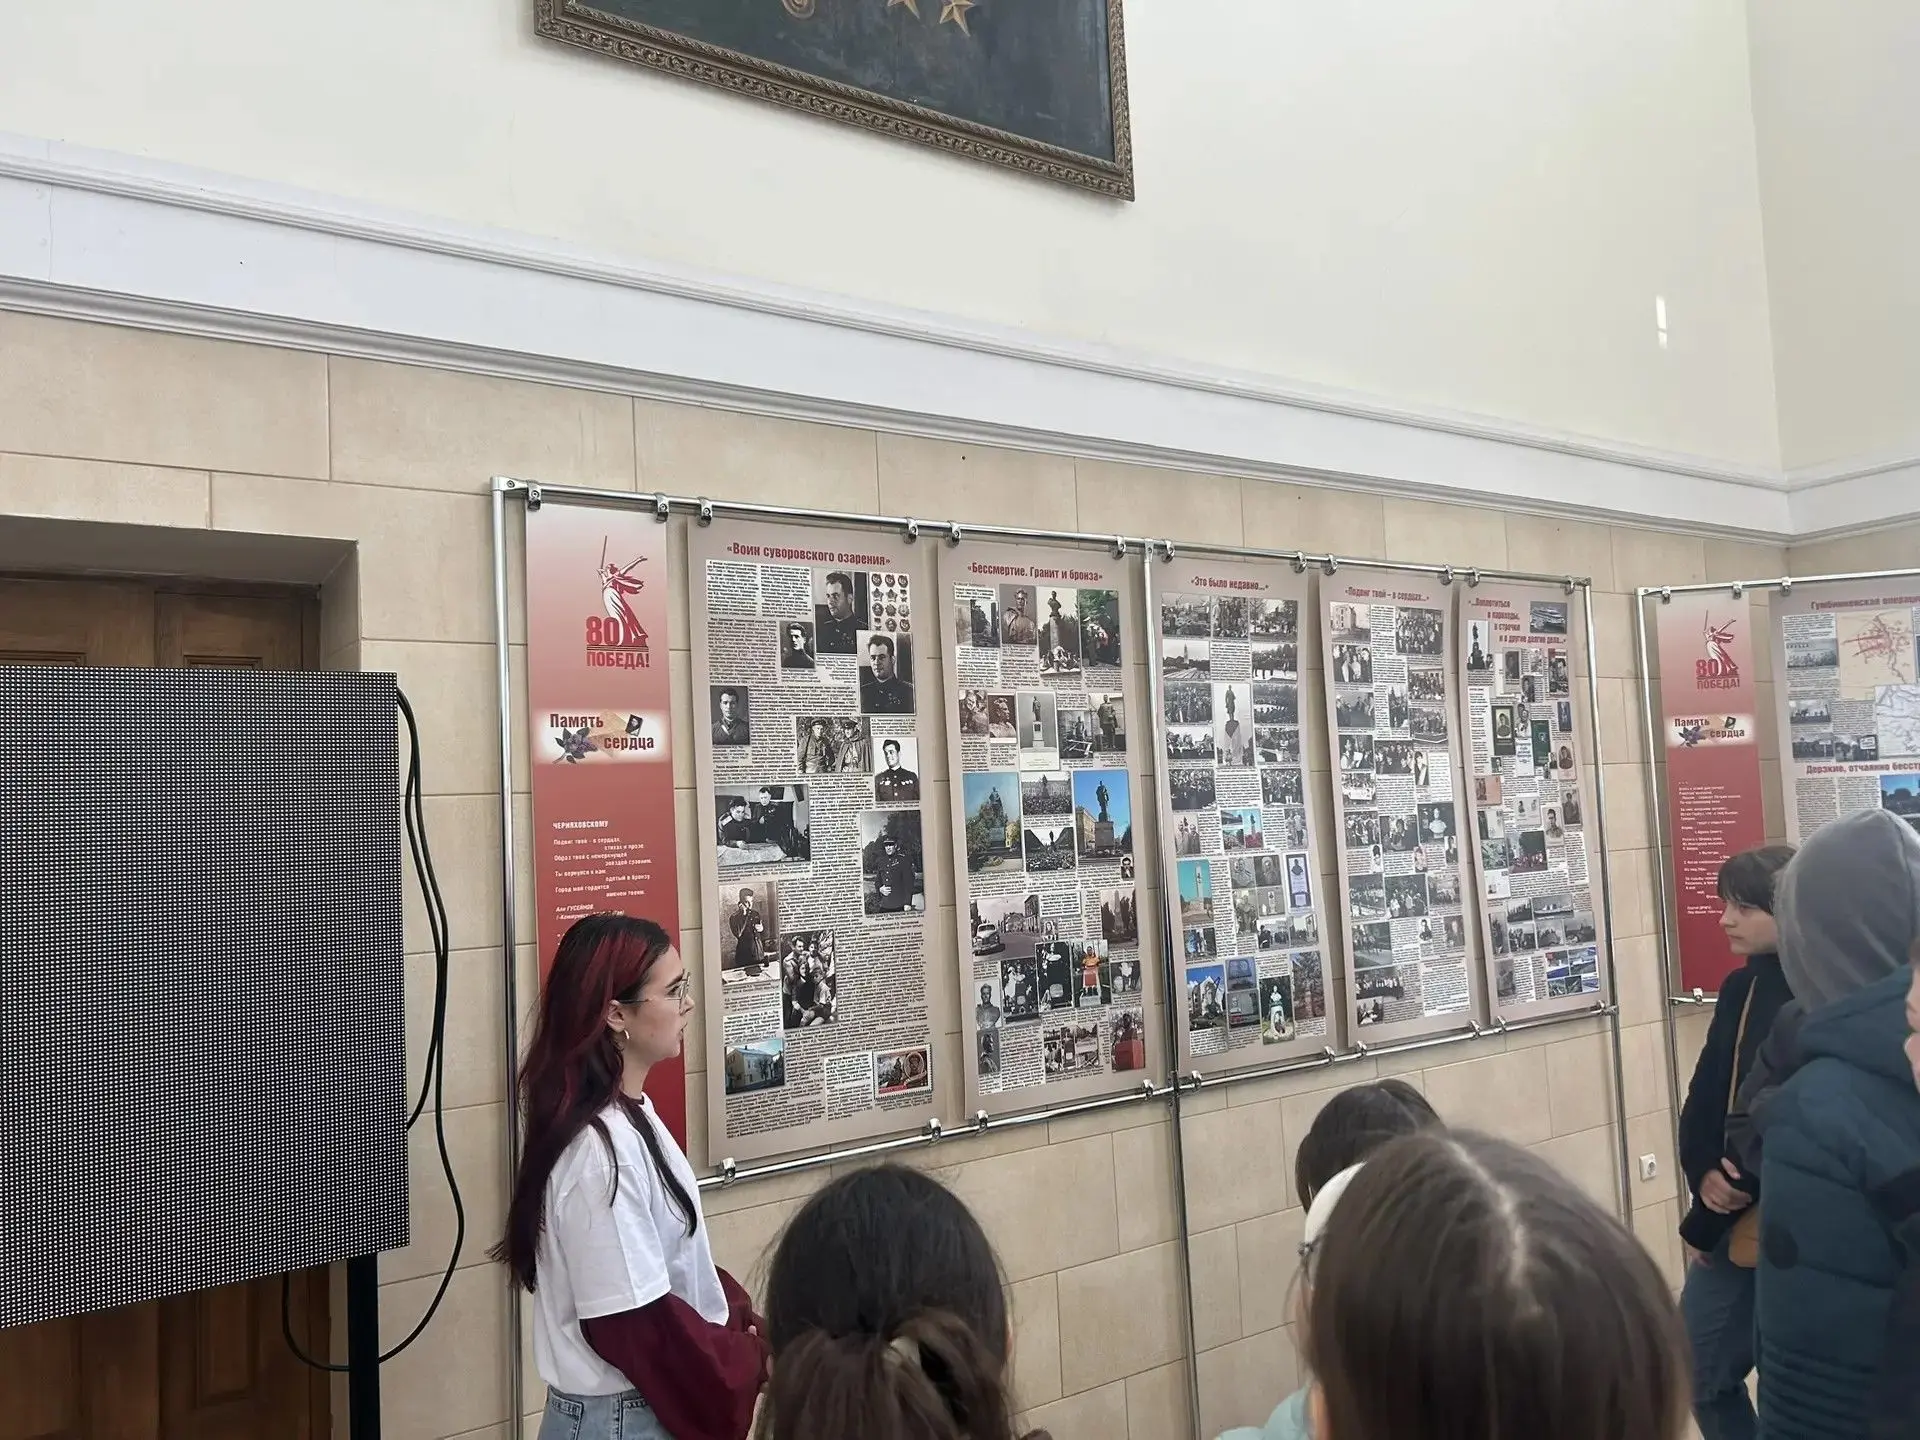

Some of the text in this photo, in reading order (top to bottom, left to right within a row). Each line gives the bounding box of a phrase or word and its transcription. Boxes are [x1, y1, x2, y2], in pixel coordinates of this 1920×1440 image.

[727, 542, 891, 566] «Воин суворовского озарения»
[967, 562, 1103, 582] «Бессмертие. Гранит и бронза»
[1208, 577, 1228, 588] было
[1372, 588, 1387, 598] твой
[586, 615, 621, 646] 80
[586, 650, 650, 670] ПОБЕДА!
[1695, 658, 1720, 677] 80
[1696, 678, 1741, 690] ПОБЕДА!
[549, 713, 605, 728] Память
[1674, 718, 1710, 728] Память
[1710, 729, 1745, 739] сердца
[603, 736, 655, 750] сердца
[552, 820, 609, 829] ЧЕРНЯХОВСКОМУ
